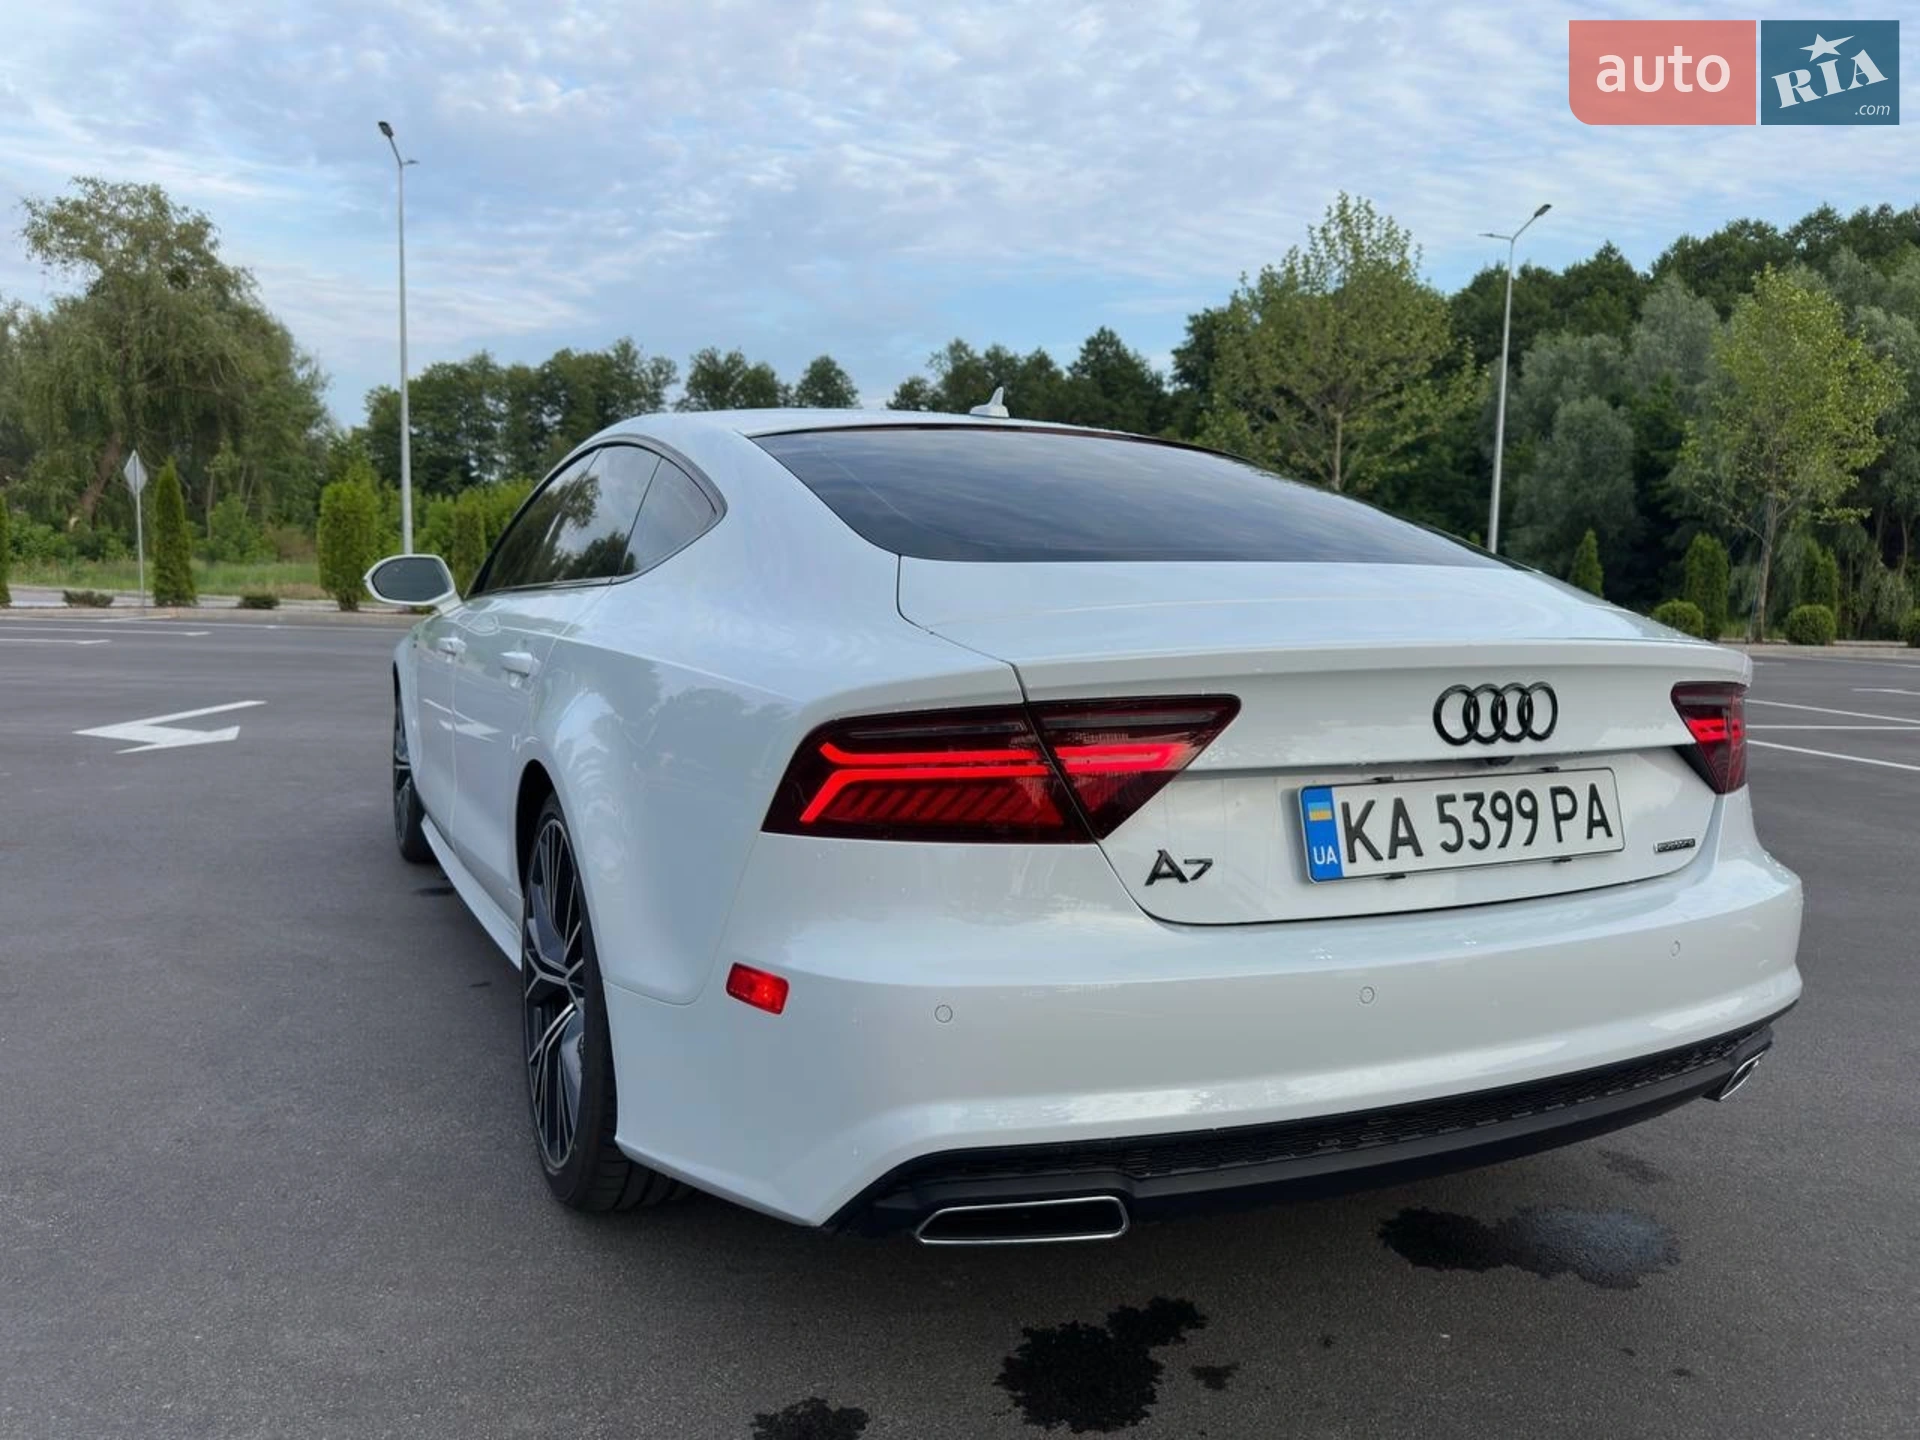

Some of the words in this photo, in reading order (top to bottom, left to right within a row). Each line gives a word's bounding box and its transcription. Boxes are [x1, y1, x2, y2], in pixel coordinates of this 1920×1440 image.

[1341, 798, 1424, 863] KA
[1436, 788, 1539, 853] 5399
[1549, 783, 1613, 843] PA
[1144, 849, 1213, 886] A7
[1313, 847, 1338, 865] UA
